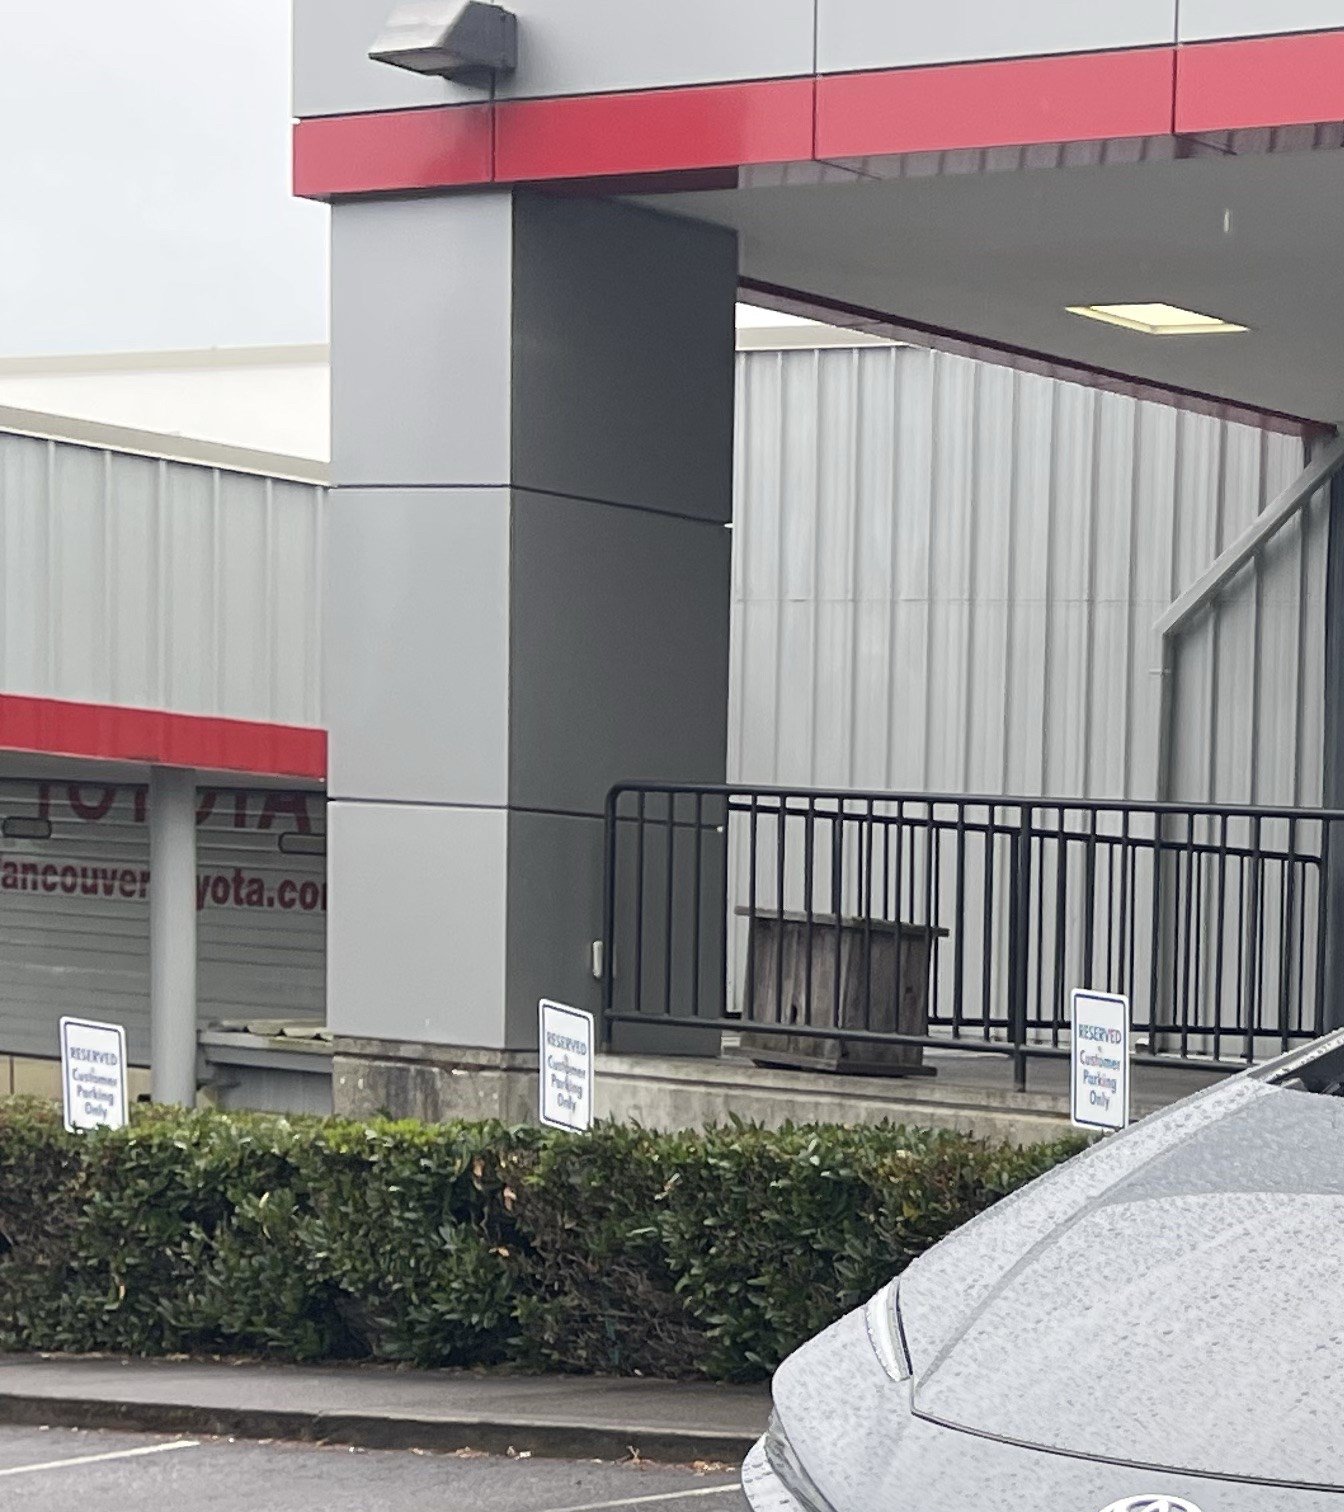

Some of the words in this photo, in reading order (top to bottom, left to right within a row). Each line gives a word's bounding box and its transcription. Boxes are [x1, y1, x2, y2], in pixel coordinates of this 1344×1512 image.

[0, 858, 327, 911] ancouveryota.co
[1079, 1024, 1122, 1044] RESERVED
[70, 1047, 117, 1066] RESERVED
[1080, 1049, 1120, 1070] Customer
[1083, 1069, 1117, 1094] Parking
[1090, 1089, 1111, 1112] Only
